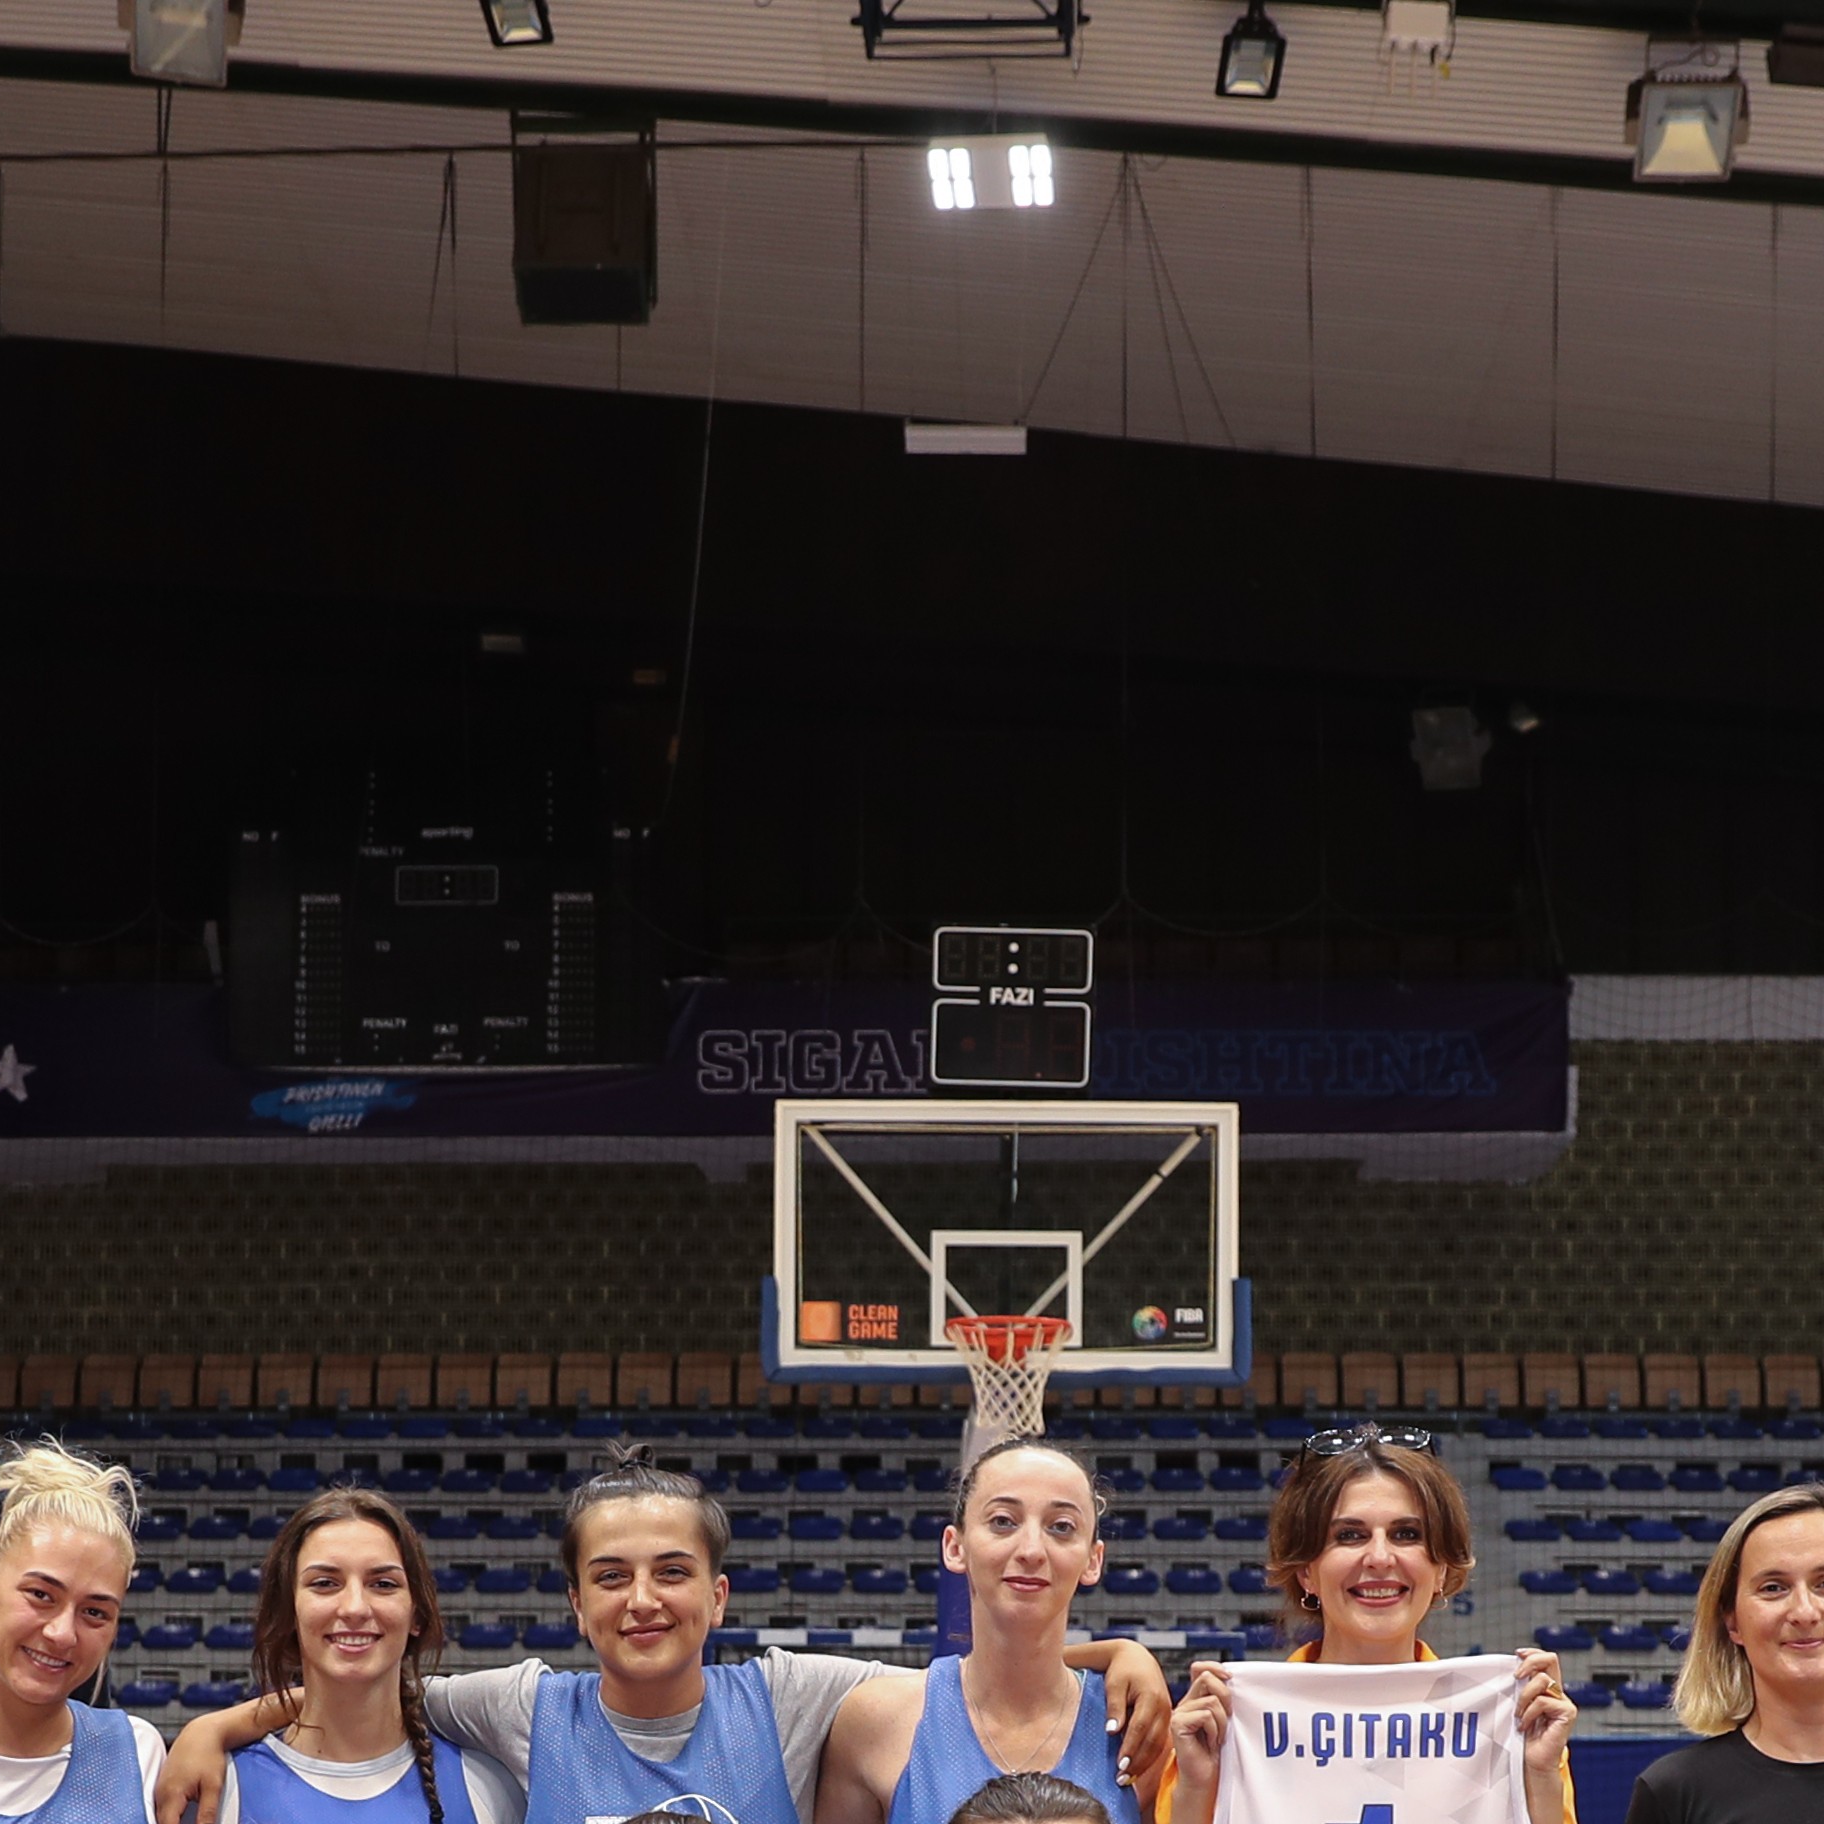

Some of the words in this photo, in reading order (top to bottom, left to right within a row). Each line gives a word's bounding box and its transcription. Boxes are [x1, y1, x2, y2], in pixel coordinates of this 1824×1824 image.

[989, 986, 1035, 1006] FAZI
[847, 1303, 899, 1321] CLEAN
[1174, 1306, 1204, 1324] FIBA
[847, 1322, 899, 1341] GAME
